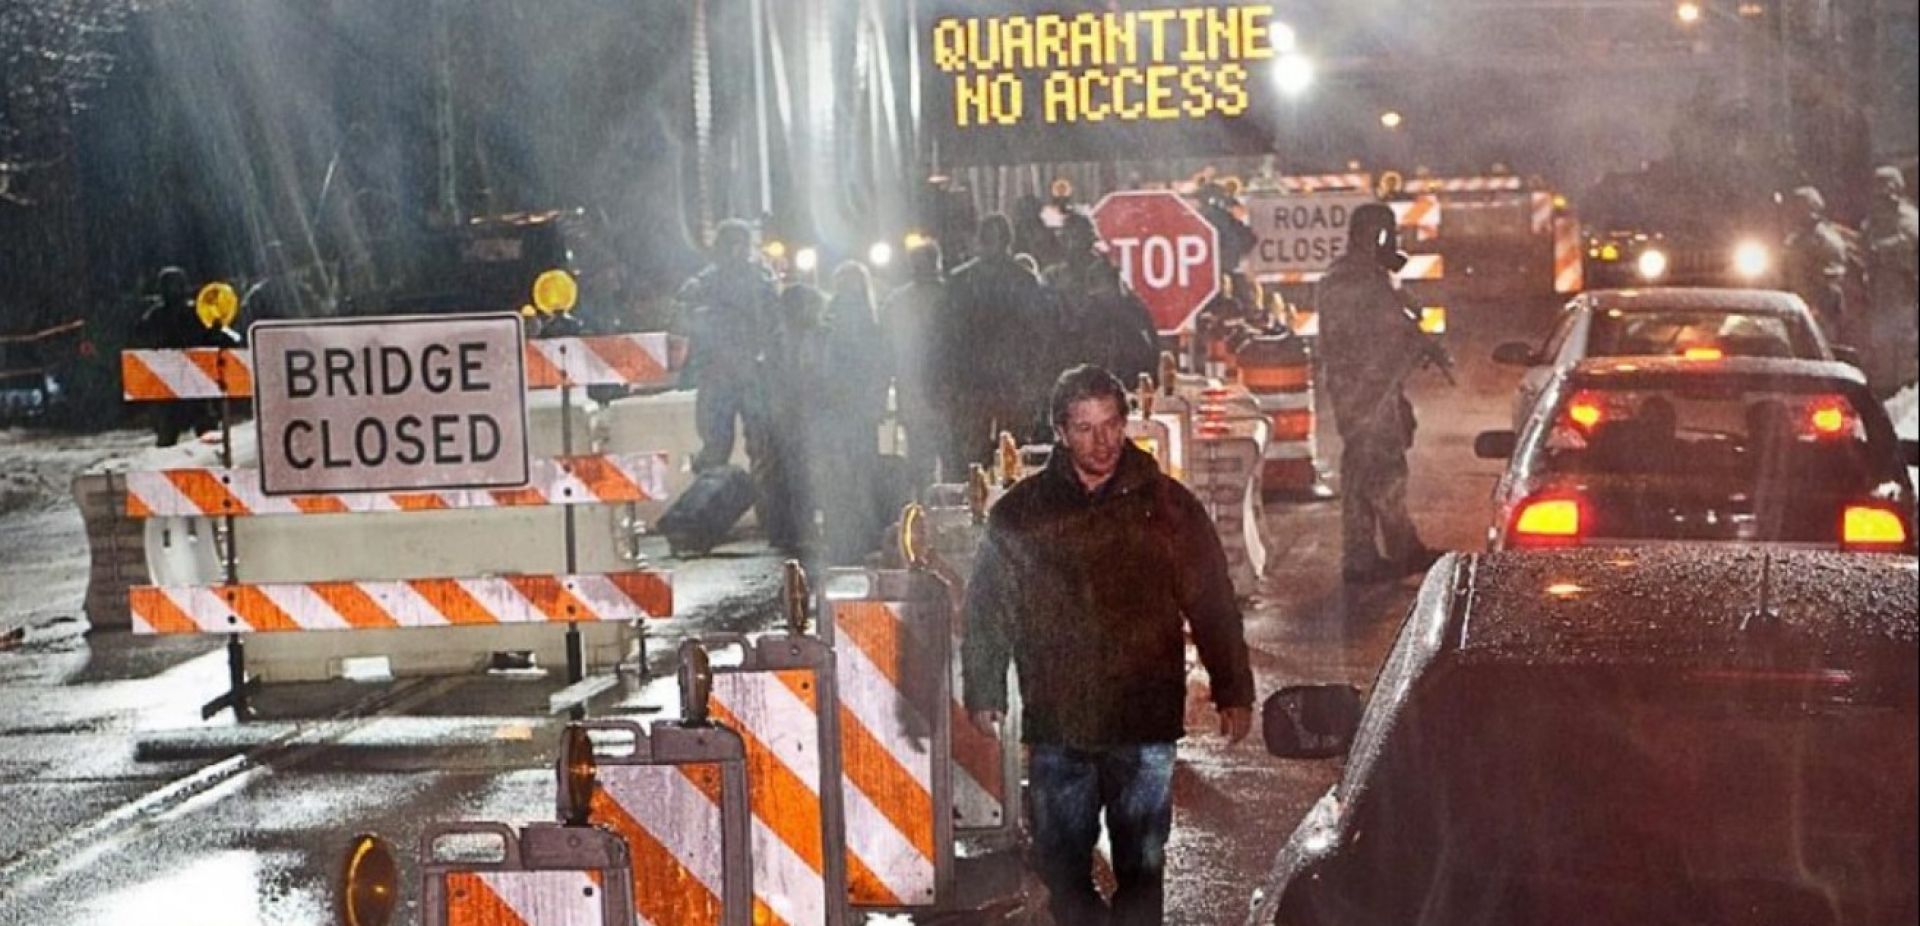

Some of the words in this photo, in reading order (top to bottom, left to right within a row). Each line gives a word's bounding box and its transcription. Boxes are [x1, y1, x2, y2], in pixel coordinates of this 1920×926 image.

[933, 6, 1275, 71] QUARANTINE
[956, 74, 1022, 126] NO
[1044, 63, 1248, 123] ACCESS
[1274, 205, 1345, 230] ROAD
[1094, 235, 1207, 289] TOP
[1260, 237, 1344, 262] CLOSE
[285, 342, 491, 398] BRIDGE
[283, 414, 501, 470] CLOSED
